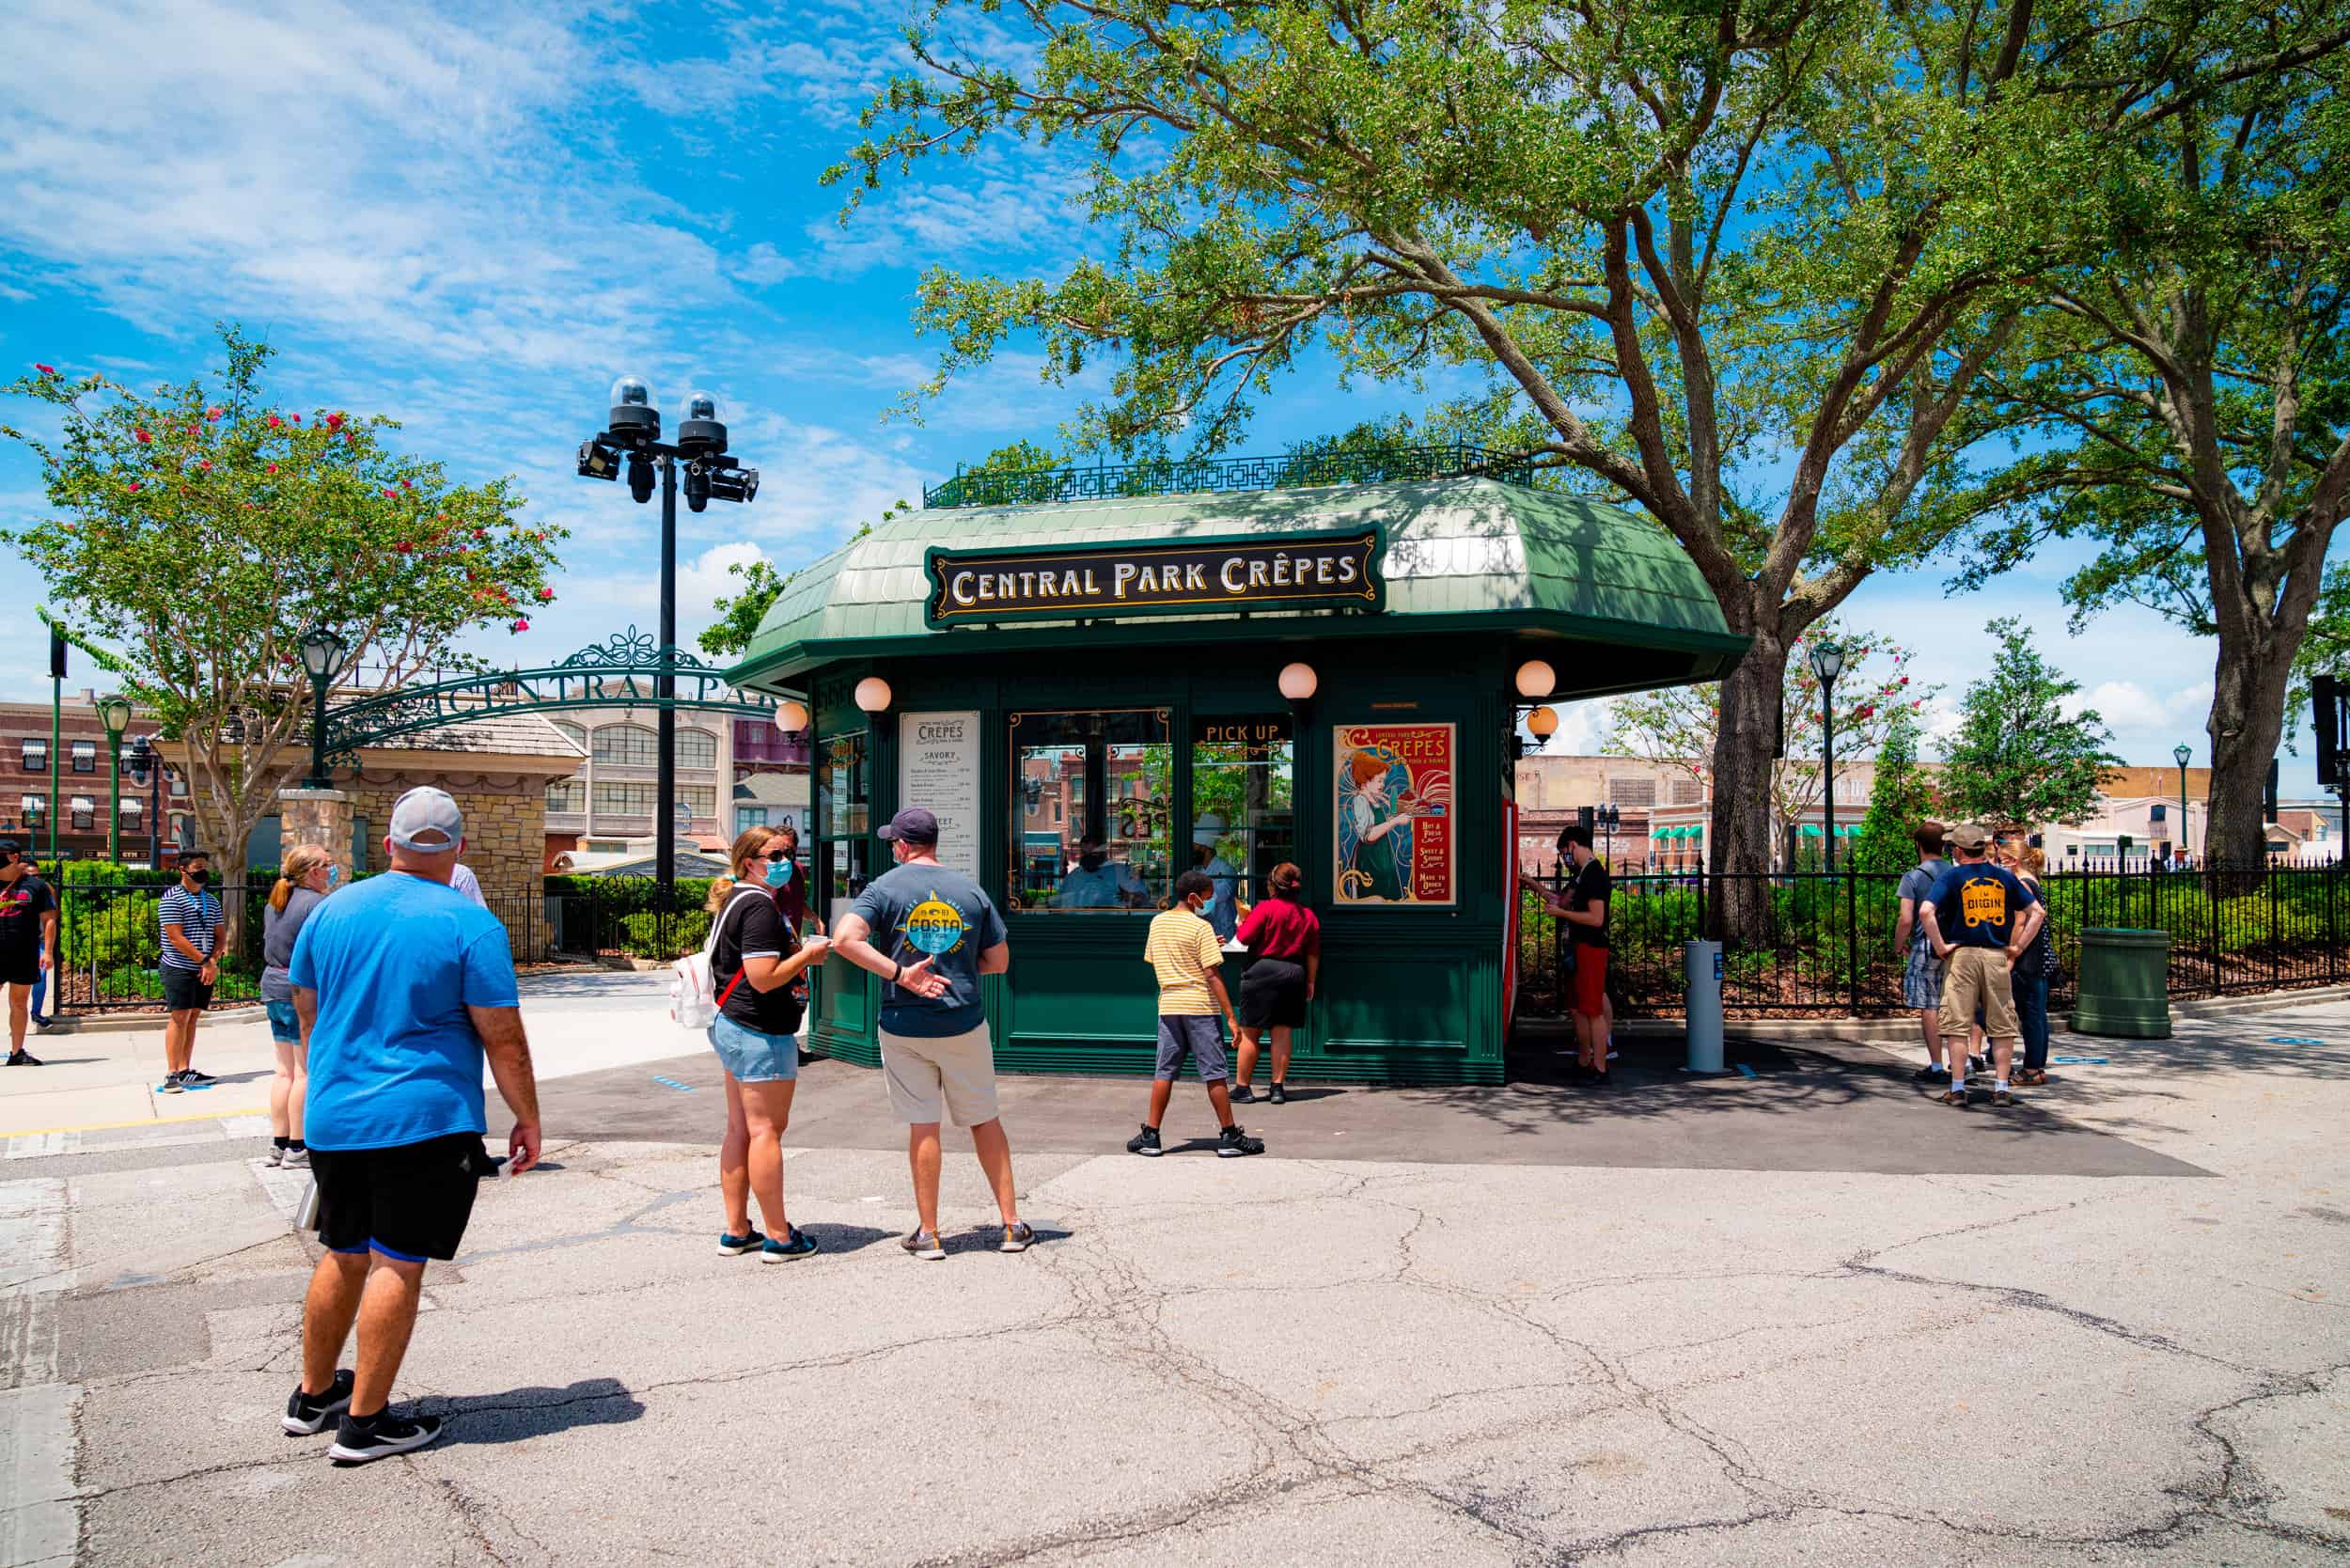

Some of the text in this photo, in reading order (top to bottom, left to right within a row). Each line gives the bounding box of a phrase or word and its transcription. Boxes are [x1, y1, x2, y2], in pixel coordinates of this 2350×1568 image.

[951, 552, 1357, 606] CENTRAL PARK CRÊPES
[1207, 725, 1279, 741] PICK UP
[924, 751, 956, 760] SAVORY
[909, 919, 960, 933] COSTA
